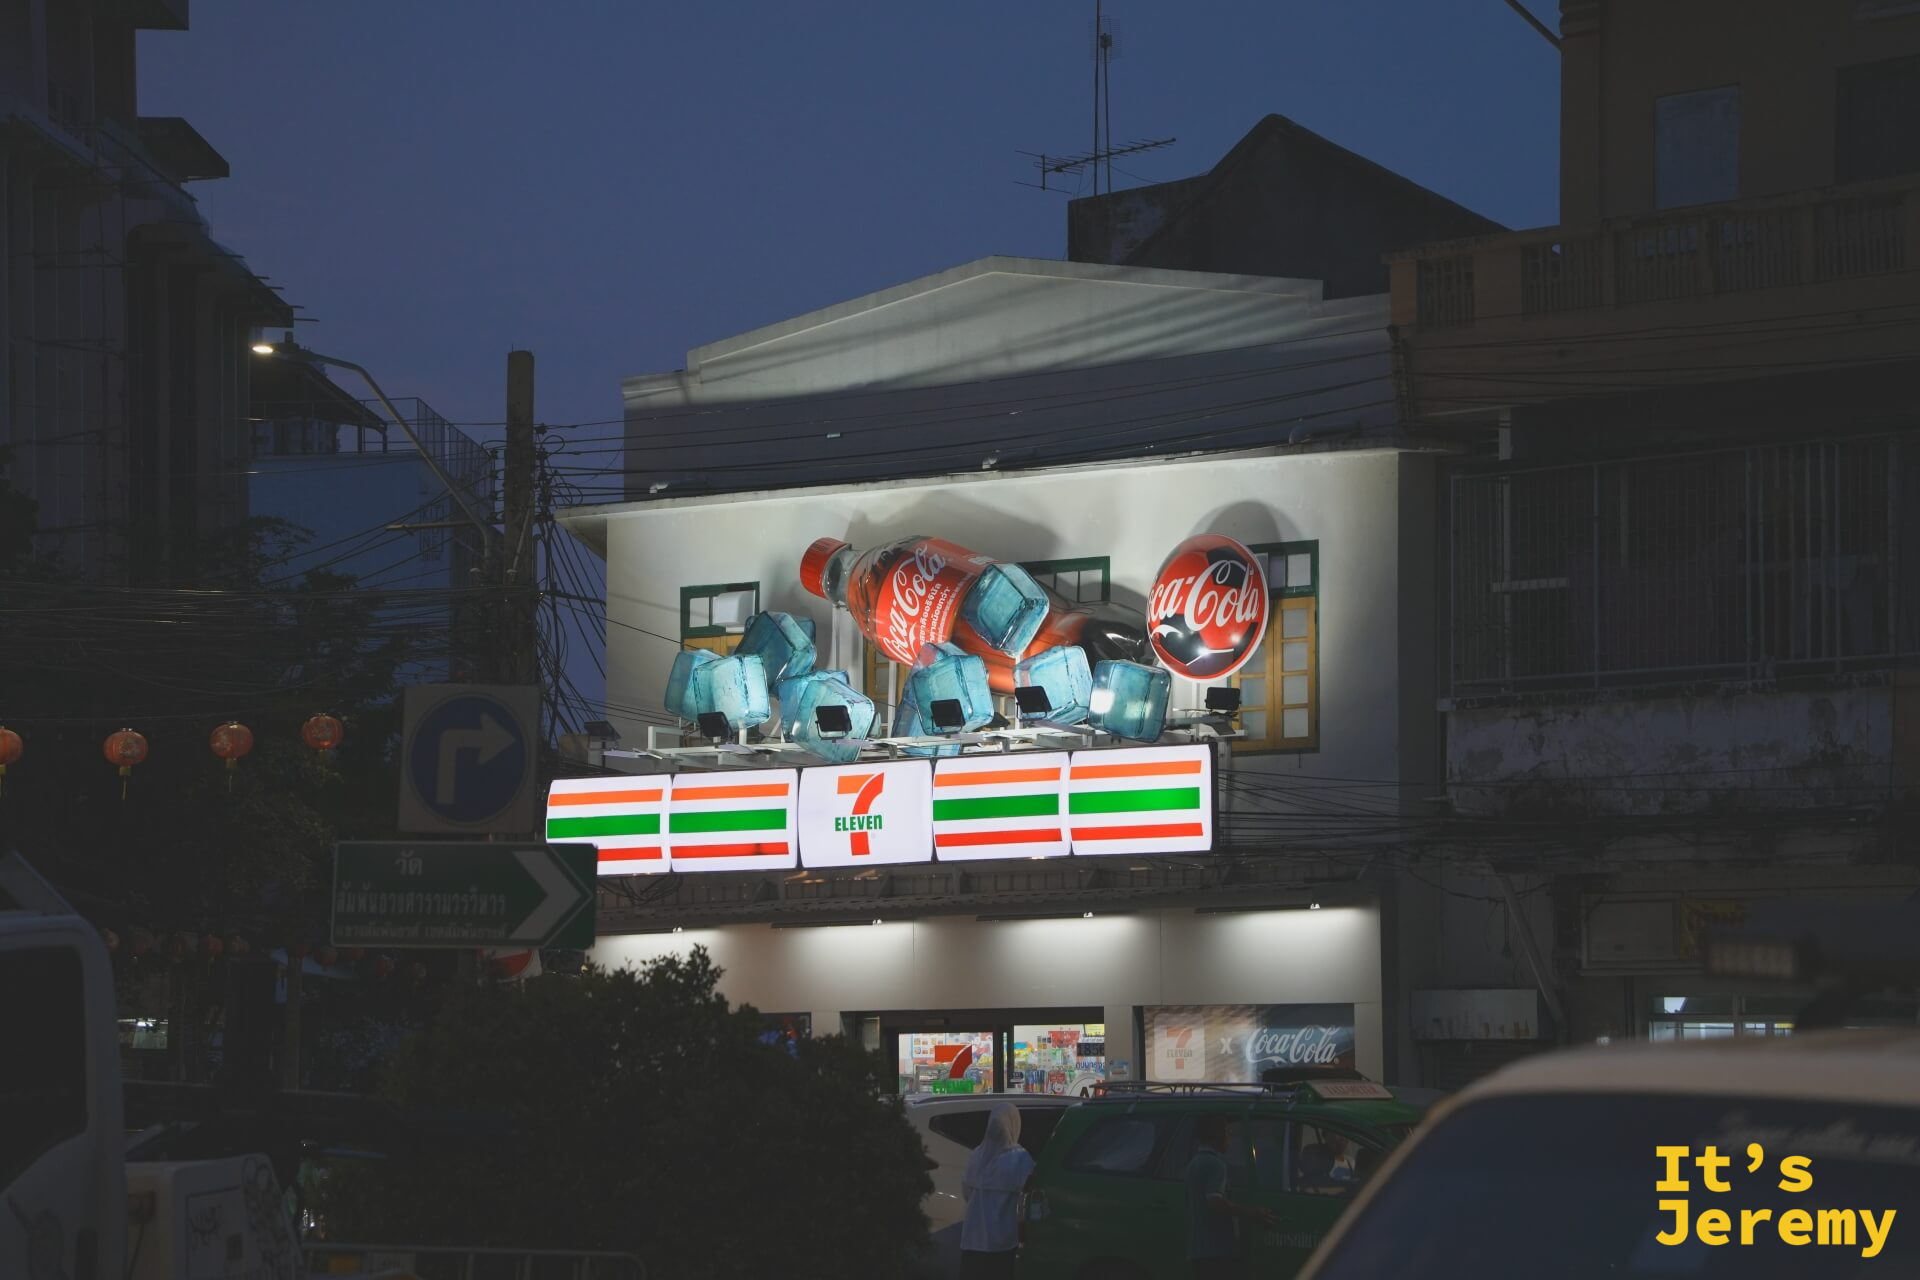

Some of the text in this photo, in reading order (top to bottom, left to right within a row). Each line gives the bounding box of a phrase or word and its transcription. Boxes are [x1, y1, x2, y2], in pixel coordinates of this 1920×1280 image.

[883, 544, 946, 666] Coca-Cola
[837, 771, 885, 856] 7
[395, 849, 424, 877] วัด
[1166, 1026, 1193, 1070] 7
[1245, 1024, 1338, 1065] Coca-Cola
